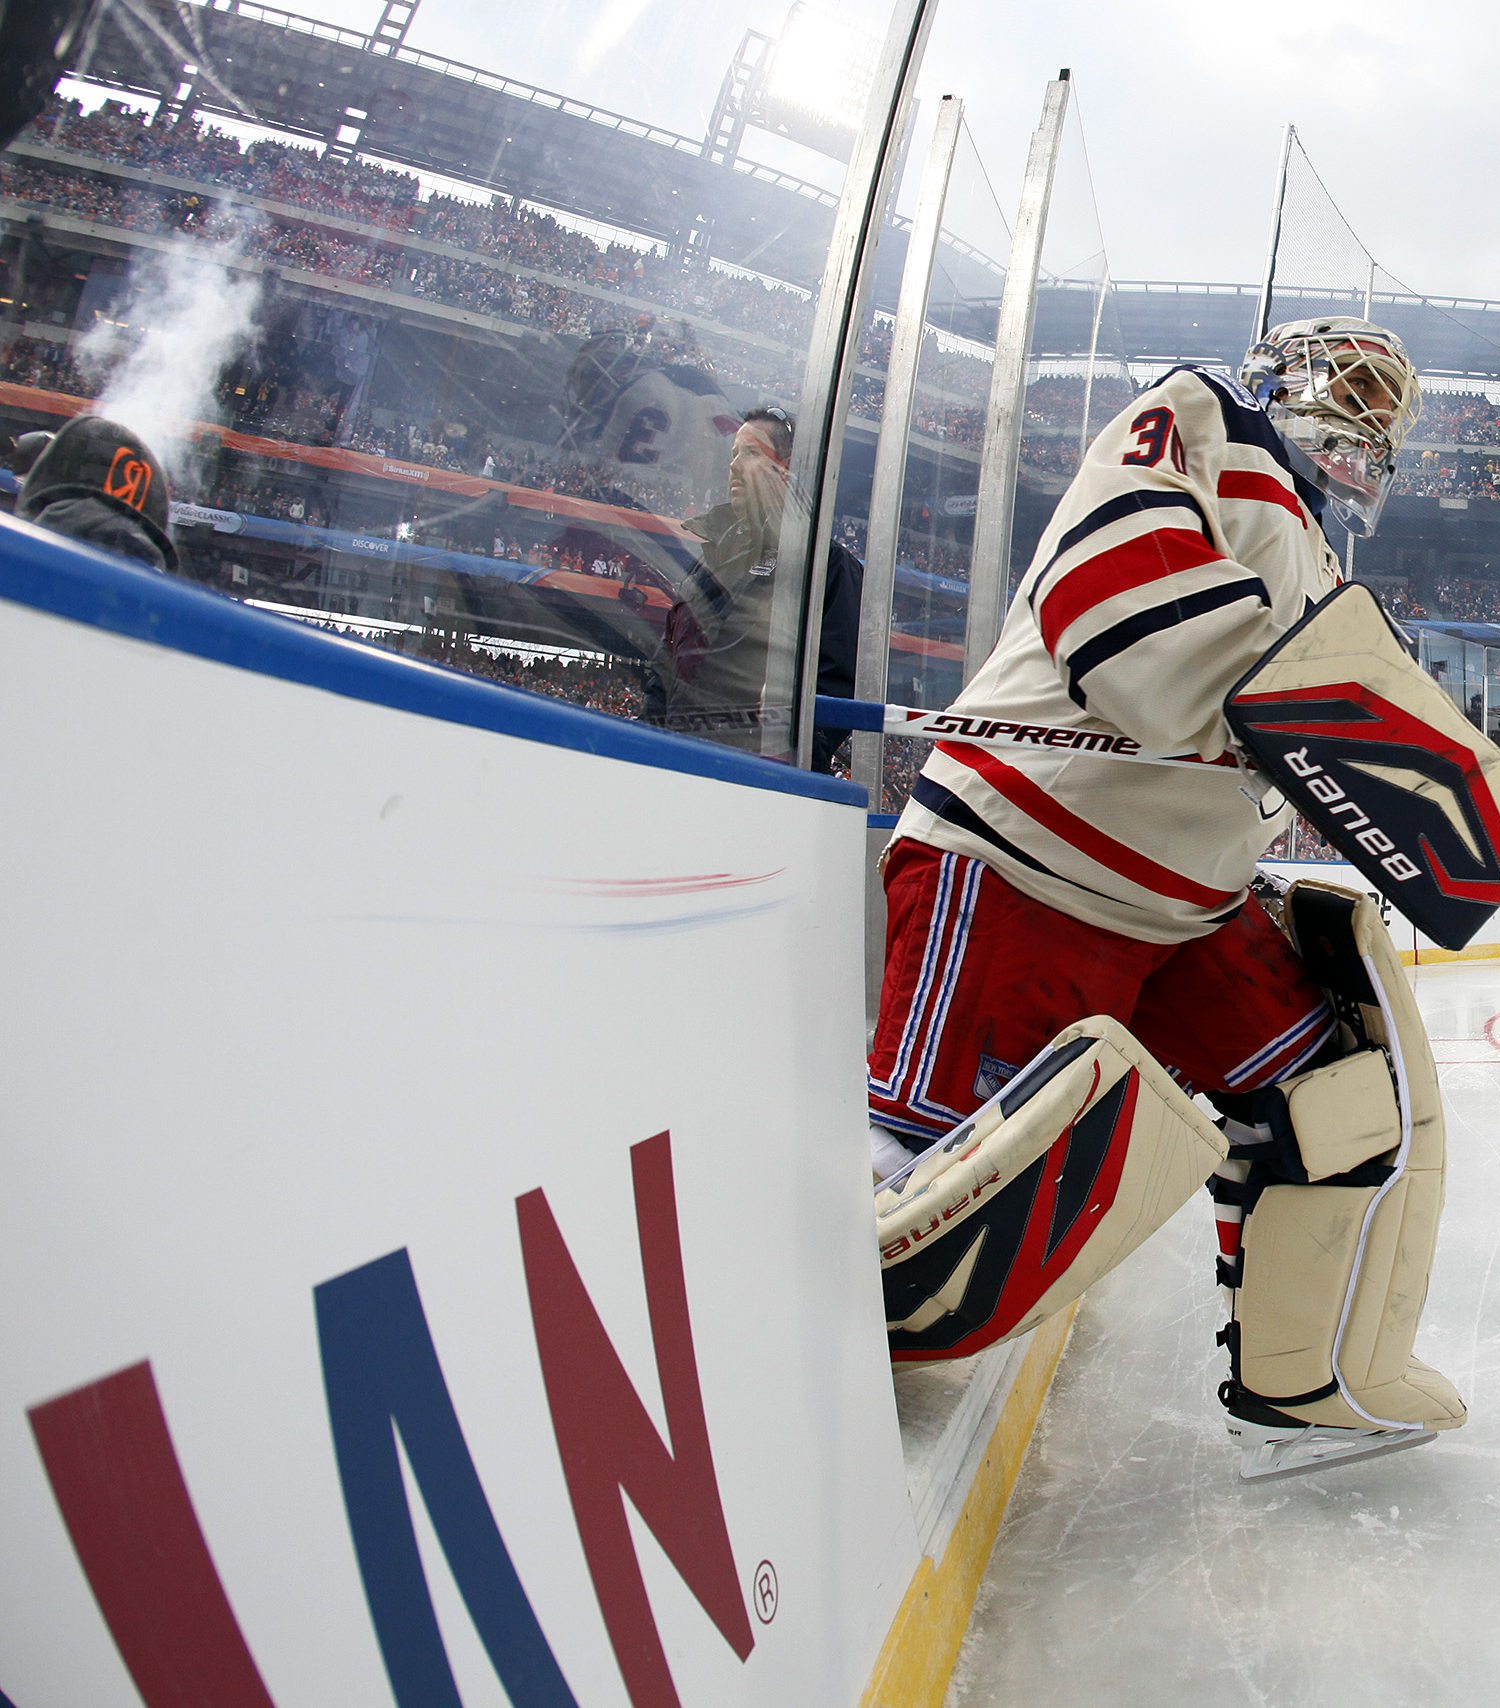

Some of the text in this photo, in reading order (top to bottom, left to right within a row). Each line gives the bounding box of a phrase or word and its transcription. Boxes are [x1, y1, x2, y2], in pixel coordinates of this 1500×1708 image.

[923, 715, 1142, 756] SUPREME
[1283, 746, 1423, 881] BAUER
[880, 1170, 1001, 1260] AUER
